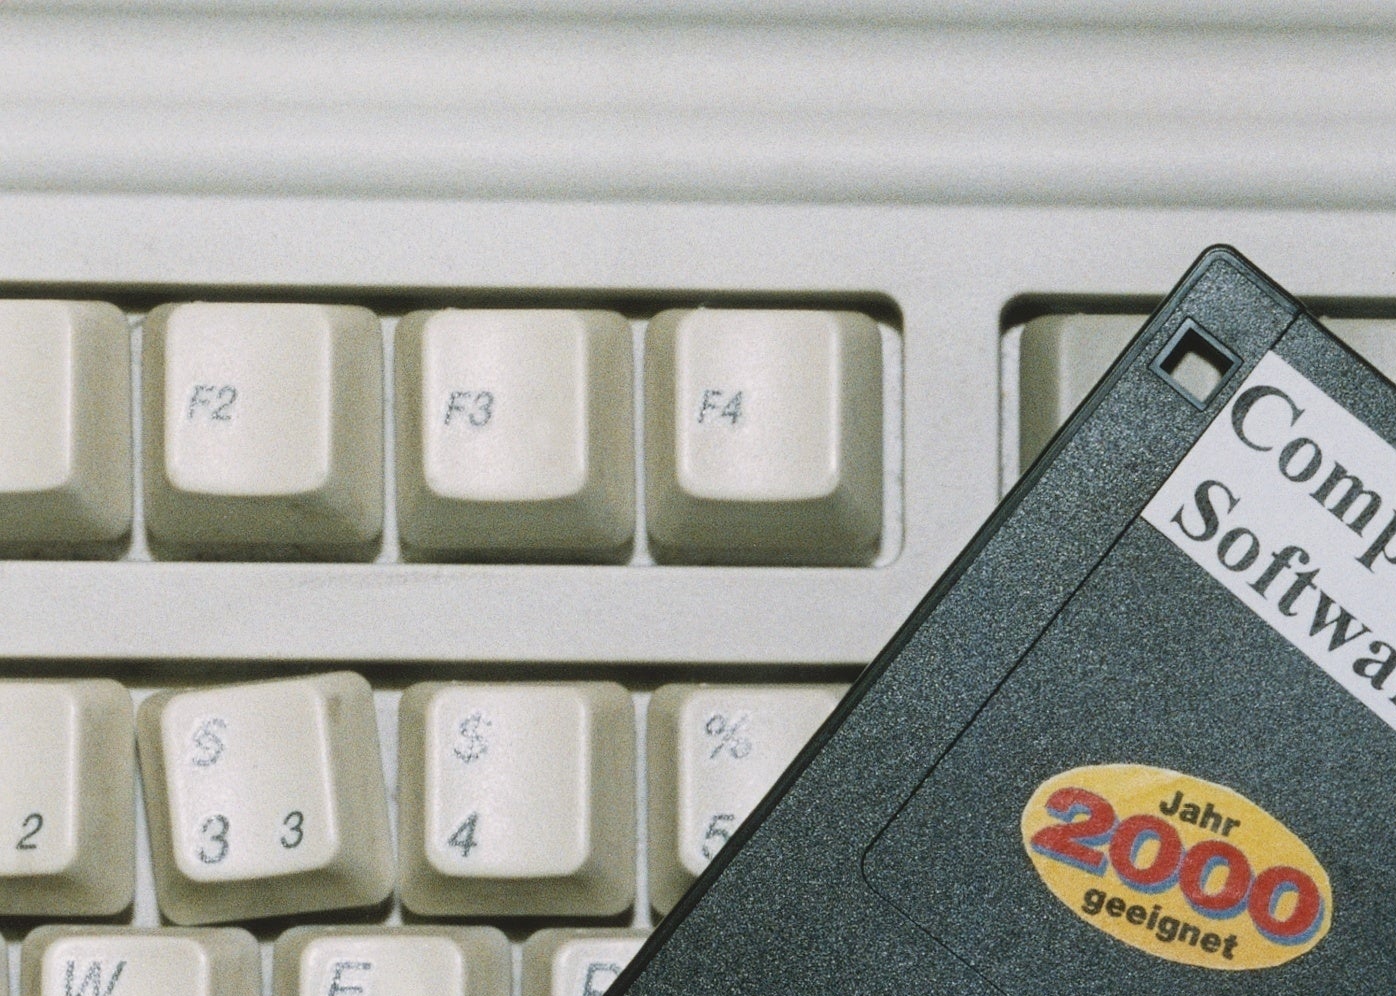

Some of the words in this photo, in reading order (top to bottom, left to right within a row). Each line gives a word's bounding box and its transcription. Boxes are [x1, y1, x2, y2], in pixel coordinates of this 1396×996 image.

[188, 384, 239, 422] F2
[443, 390, 495, 429] F3
[697, 389, 743, 426] F4
[450, 714, 491, 765] $
[704, 713, 752, 760] %
[447, 813, 479, 858] 4
[1158, 791, 1240, 838] Jahr
[198, 814, 231, 865] 3
[1031, 787, 1325, 946] 2000
[1082, 888, 1239, 960] geeignet
